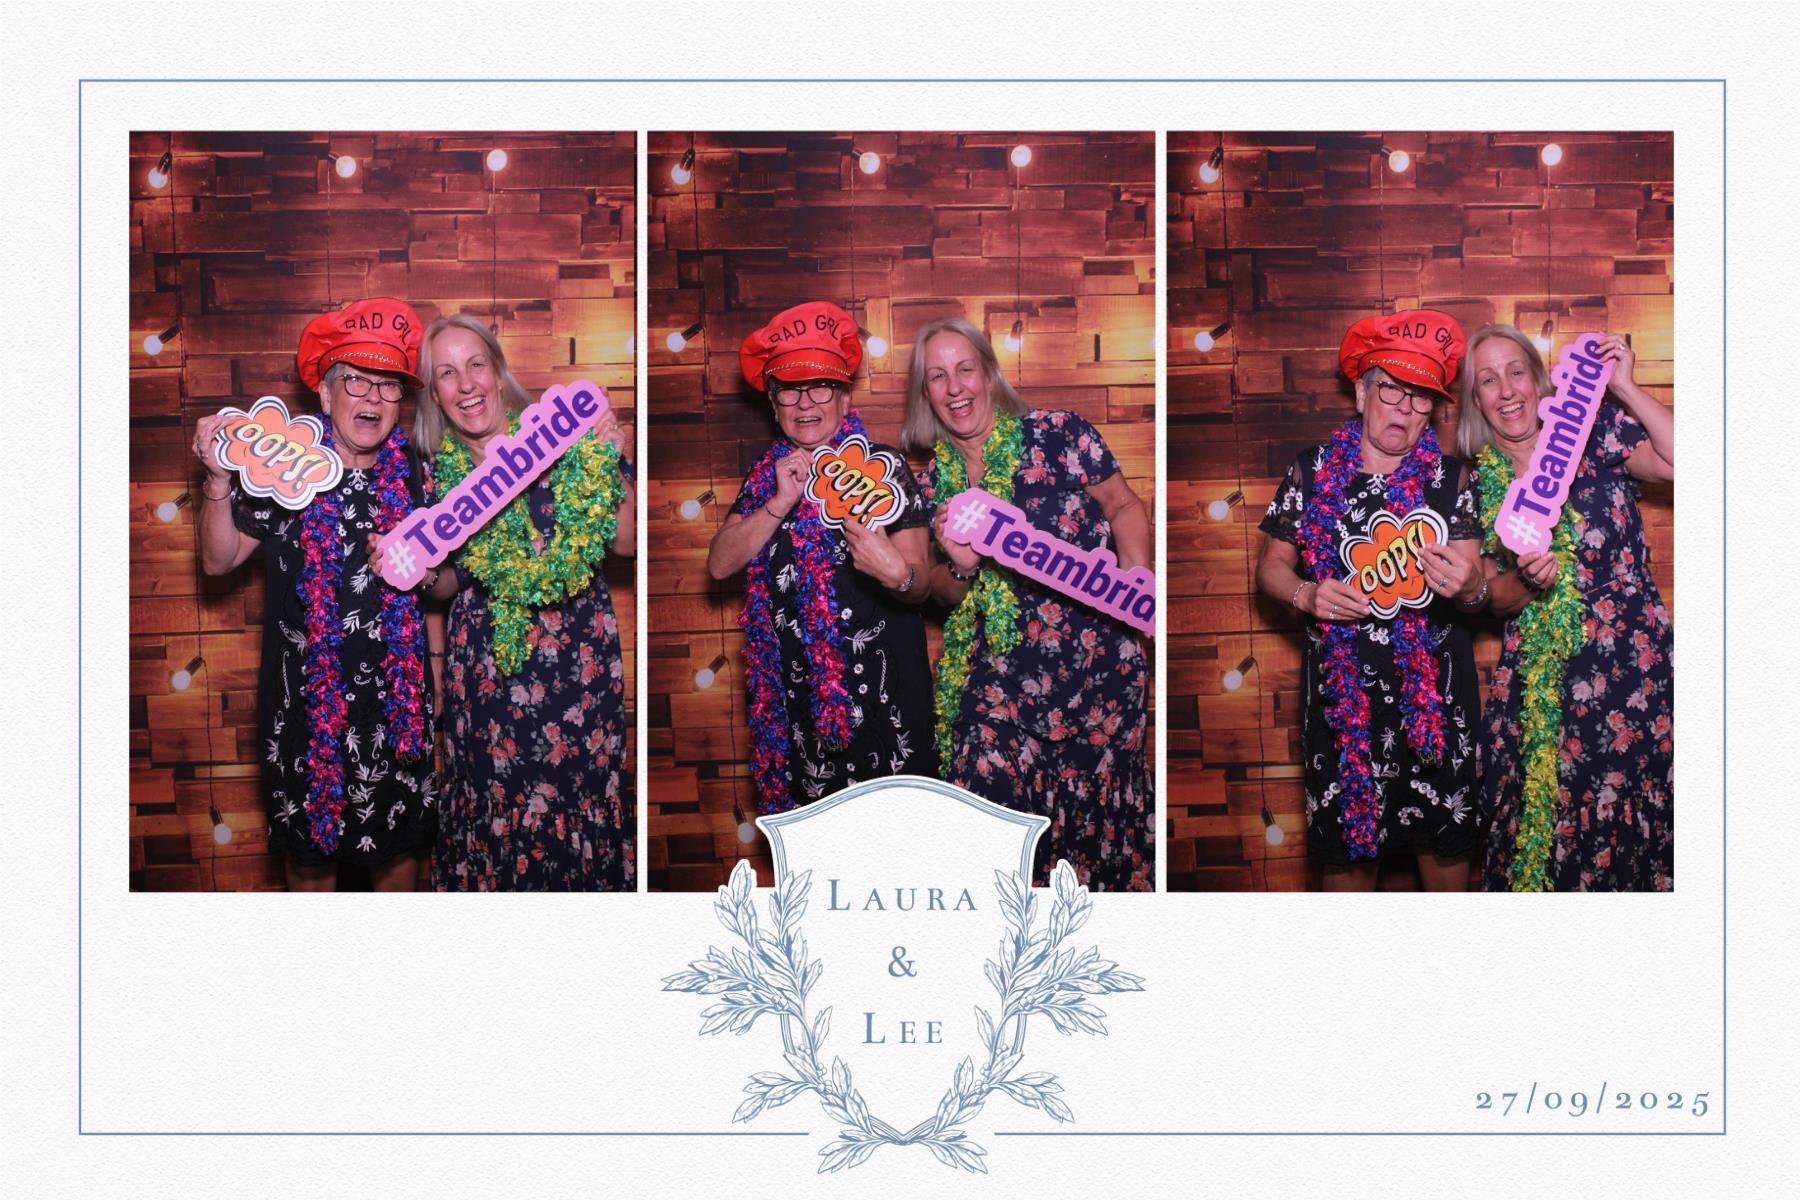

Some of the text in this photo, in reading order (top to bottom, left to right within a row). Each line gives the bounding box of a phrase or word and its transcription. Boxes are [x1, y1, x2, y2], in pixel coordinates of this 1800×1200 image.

[232, 422, 333, 493] OOPS!
[387, 388, 600, 580] #Teambride
[821, 459, 896, 524] OOPS!
[1505, 339, 1610, 546] #Teambride
